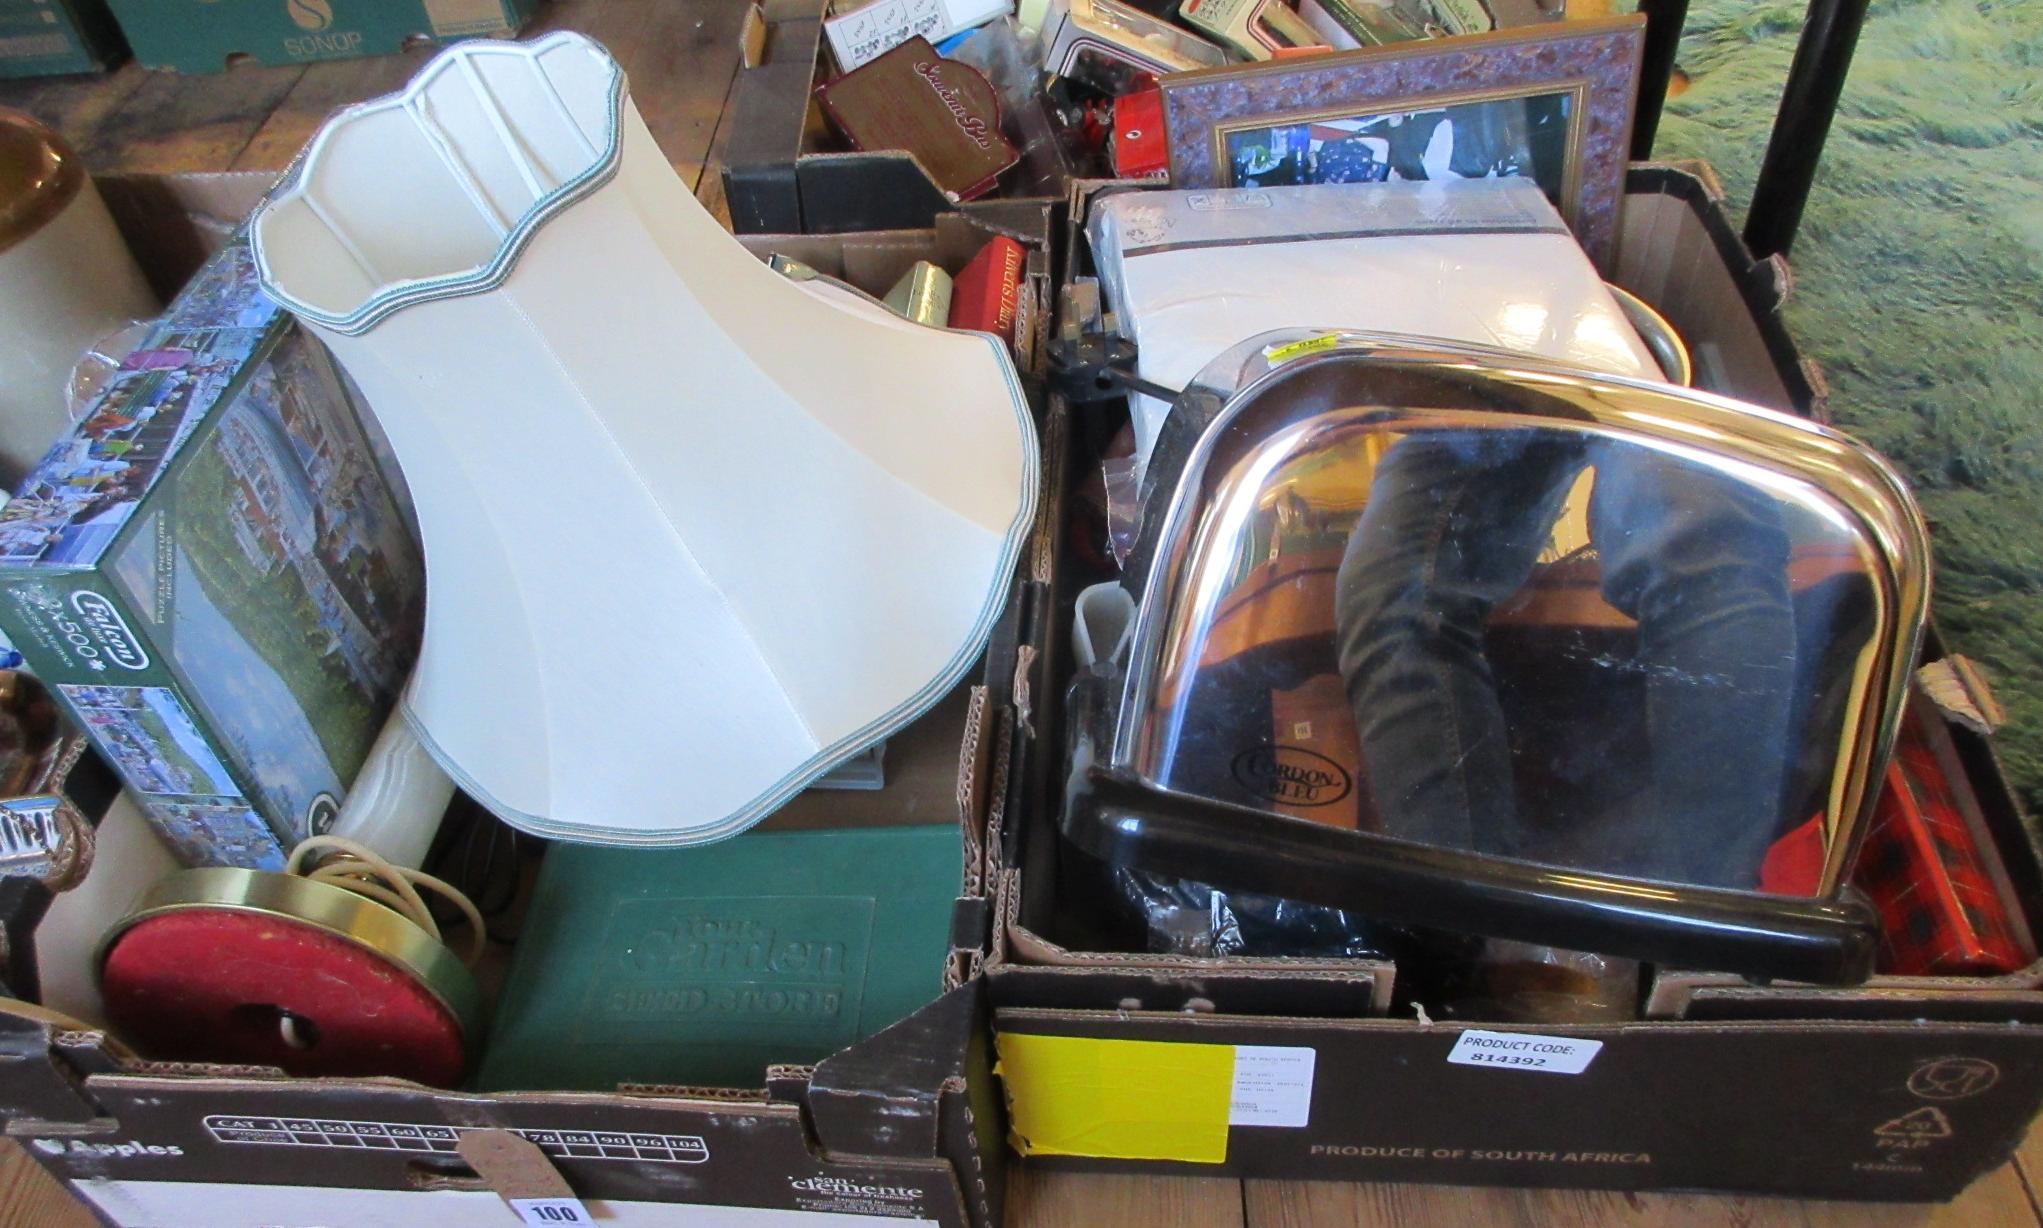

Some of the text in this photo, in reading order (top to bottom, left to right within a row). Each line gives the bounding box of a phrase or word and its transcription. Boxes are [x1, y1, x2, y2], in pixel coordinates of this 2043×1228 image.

[283, 31, 363, 56] SONOP
[914, 62, 992, 150] Souvenir Bus
[157, 509, 165, 623] PUZZLE PICTURES
[83, 600, 136, 661] Falcon
[1463, 1036, 1576, 1056] PRODUCT CODE:
[1470, 1053, 1546, 1067] 814392
[217, 1120, 255, 1129] CAT
[290, 1123, 313, 1131] 45
[323, 1125, 347, 1133] 50
[357, 1126, 381, 1135] 55
[391, 1128, 415, 1137] 60
[426, 1129, 450, 1138] 65
[529, 1134, 555, 1142] 78
[566, 1135, 591, 1144] 84
[600, 1136, 626, 1145] 90
[636, 1138, 662, 1147] 96
[669, 1139, 701, 1149] 104
[70, 1140, 184, 1157] Apples
[1309, 1144, 1652, 1164] PRODUCE OF SOUTH AFRICA
[791, 1177, 924, 1198] clemente
[531, 1206, 579, 1222] 100
